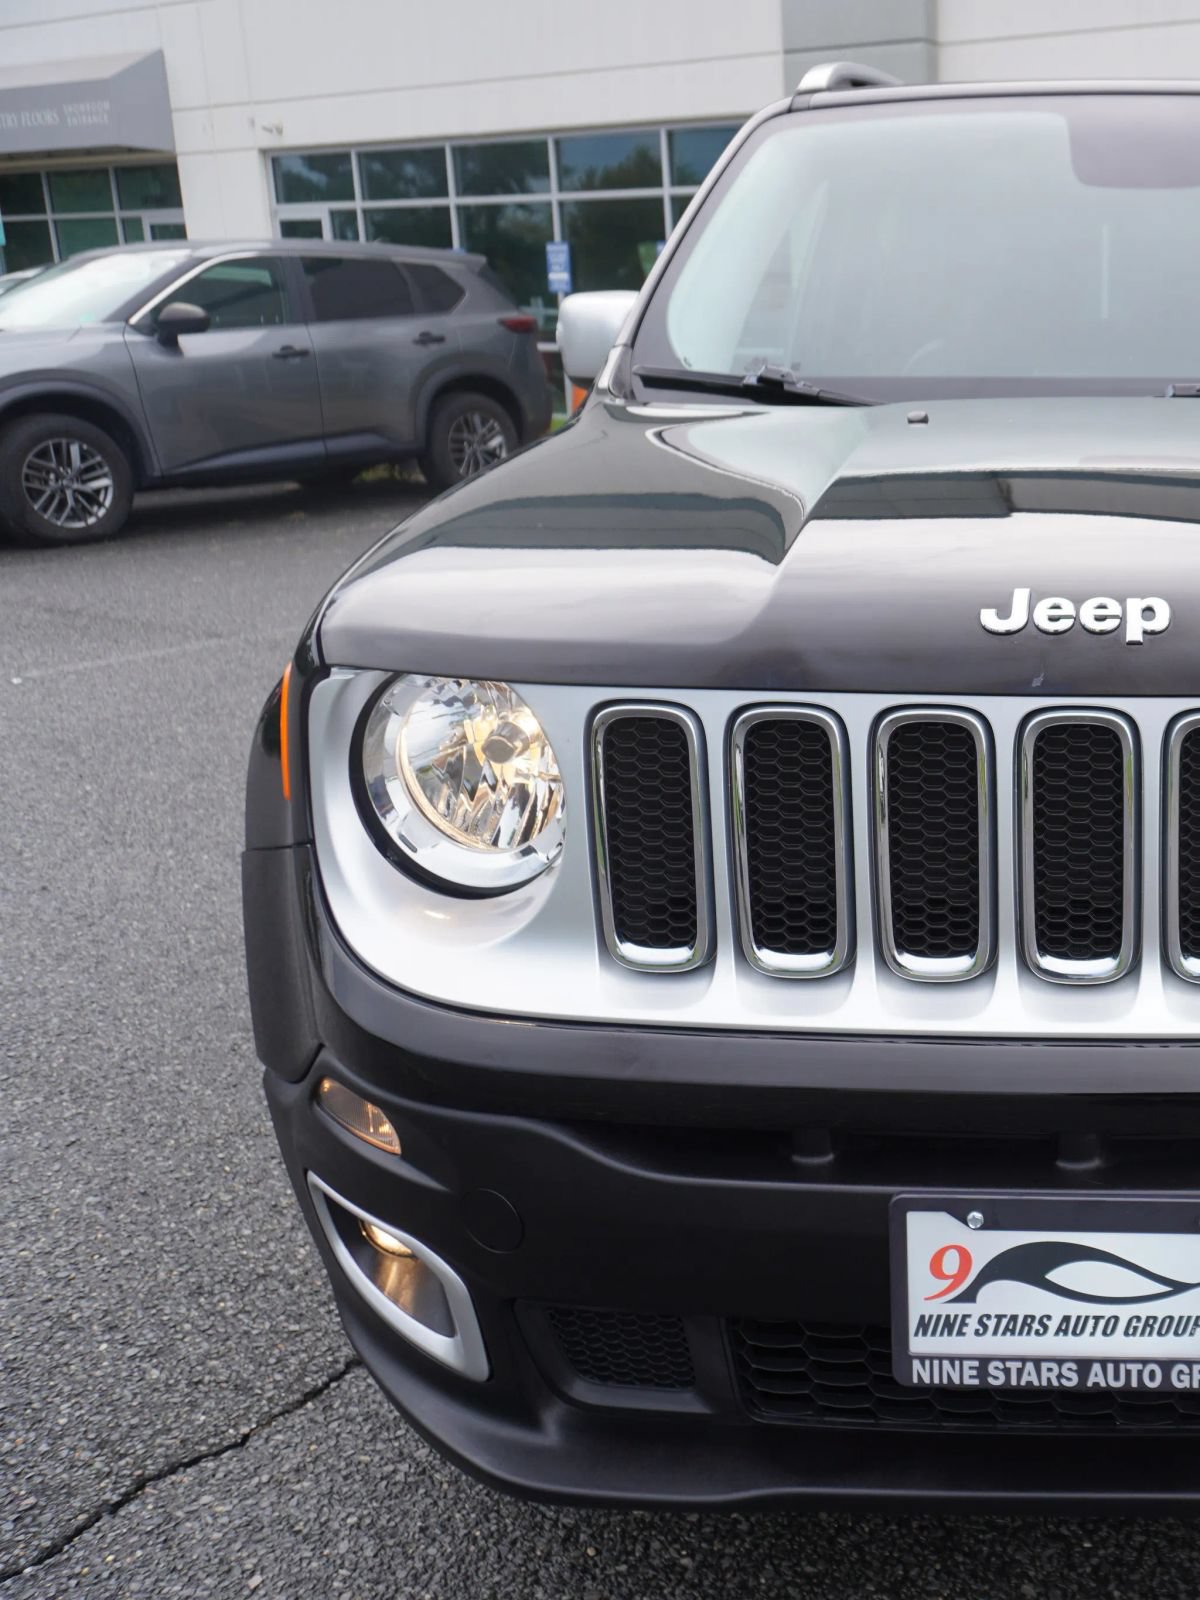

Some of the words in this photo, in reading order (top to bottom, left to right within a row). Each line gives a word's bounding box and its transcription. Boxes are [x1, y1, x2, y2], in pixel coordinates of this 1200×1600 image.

[20, 109, 60, 128] FLOORS
[979, 588, 1172, 646] Jeep
[923, 1244, 973, 1301] 9
[913, 1313, 972, 1338] NINE
[974, 1313, 1052, 1338] STARS
[1054, 1314, 1120, 1338] AUTO
[912, 1359, 980, 1386] NINE
[987, 1360, 1079, 1388] STARS
[1087, 1363, 1162, 1388] AUTO
